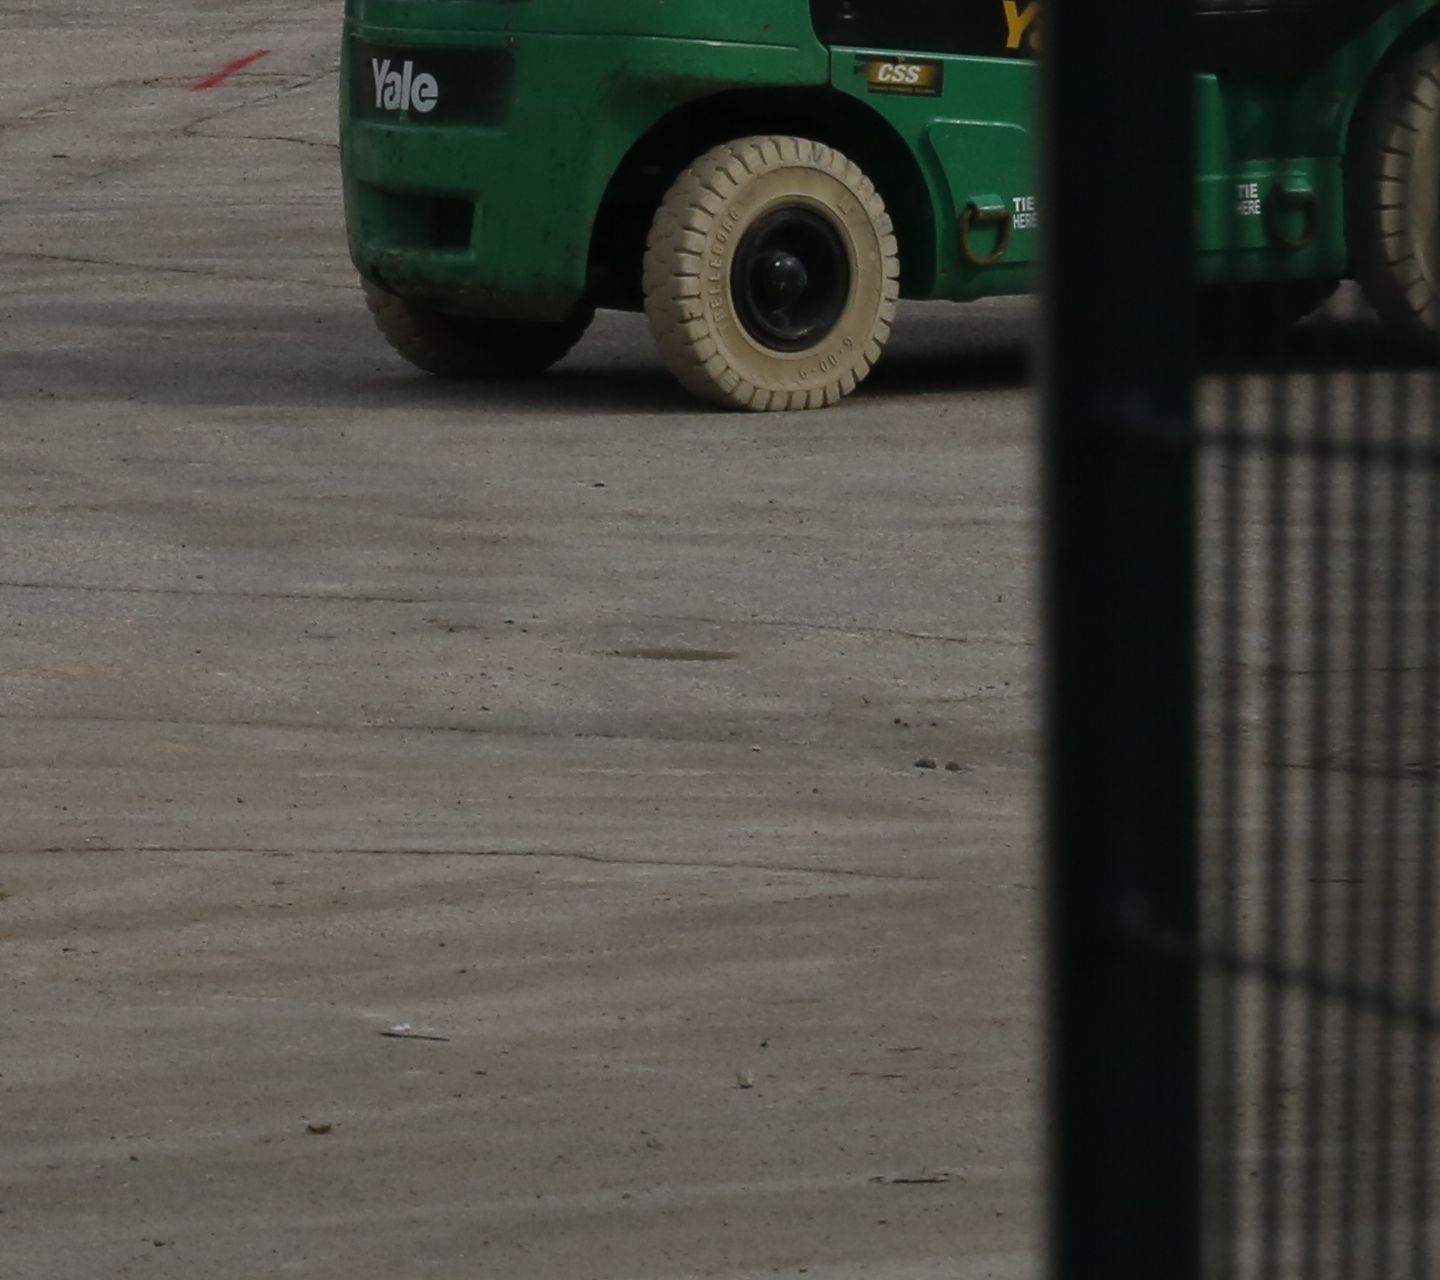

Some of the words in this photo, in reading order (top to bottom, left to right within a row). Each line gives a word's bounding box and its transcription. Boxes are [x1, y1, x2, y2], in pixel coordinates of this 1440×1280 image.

[877, 63, 922, 84] CSS
[372, 58, 439, 113] Yale
[1012, 196, 1035, 212] TIE
